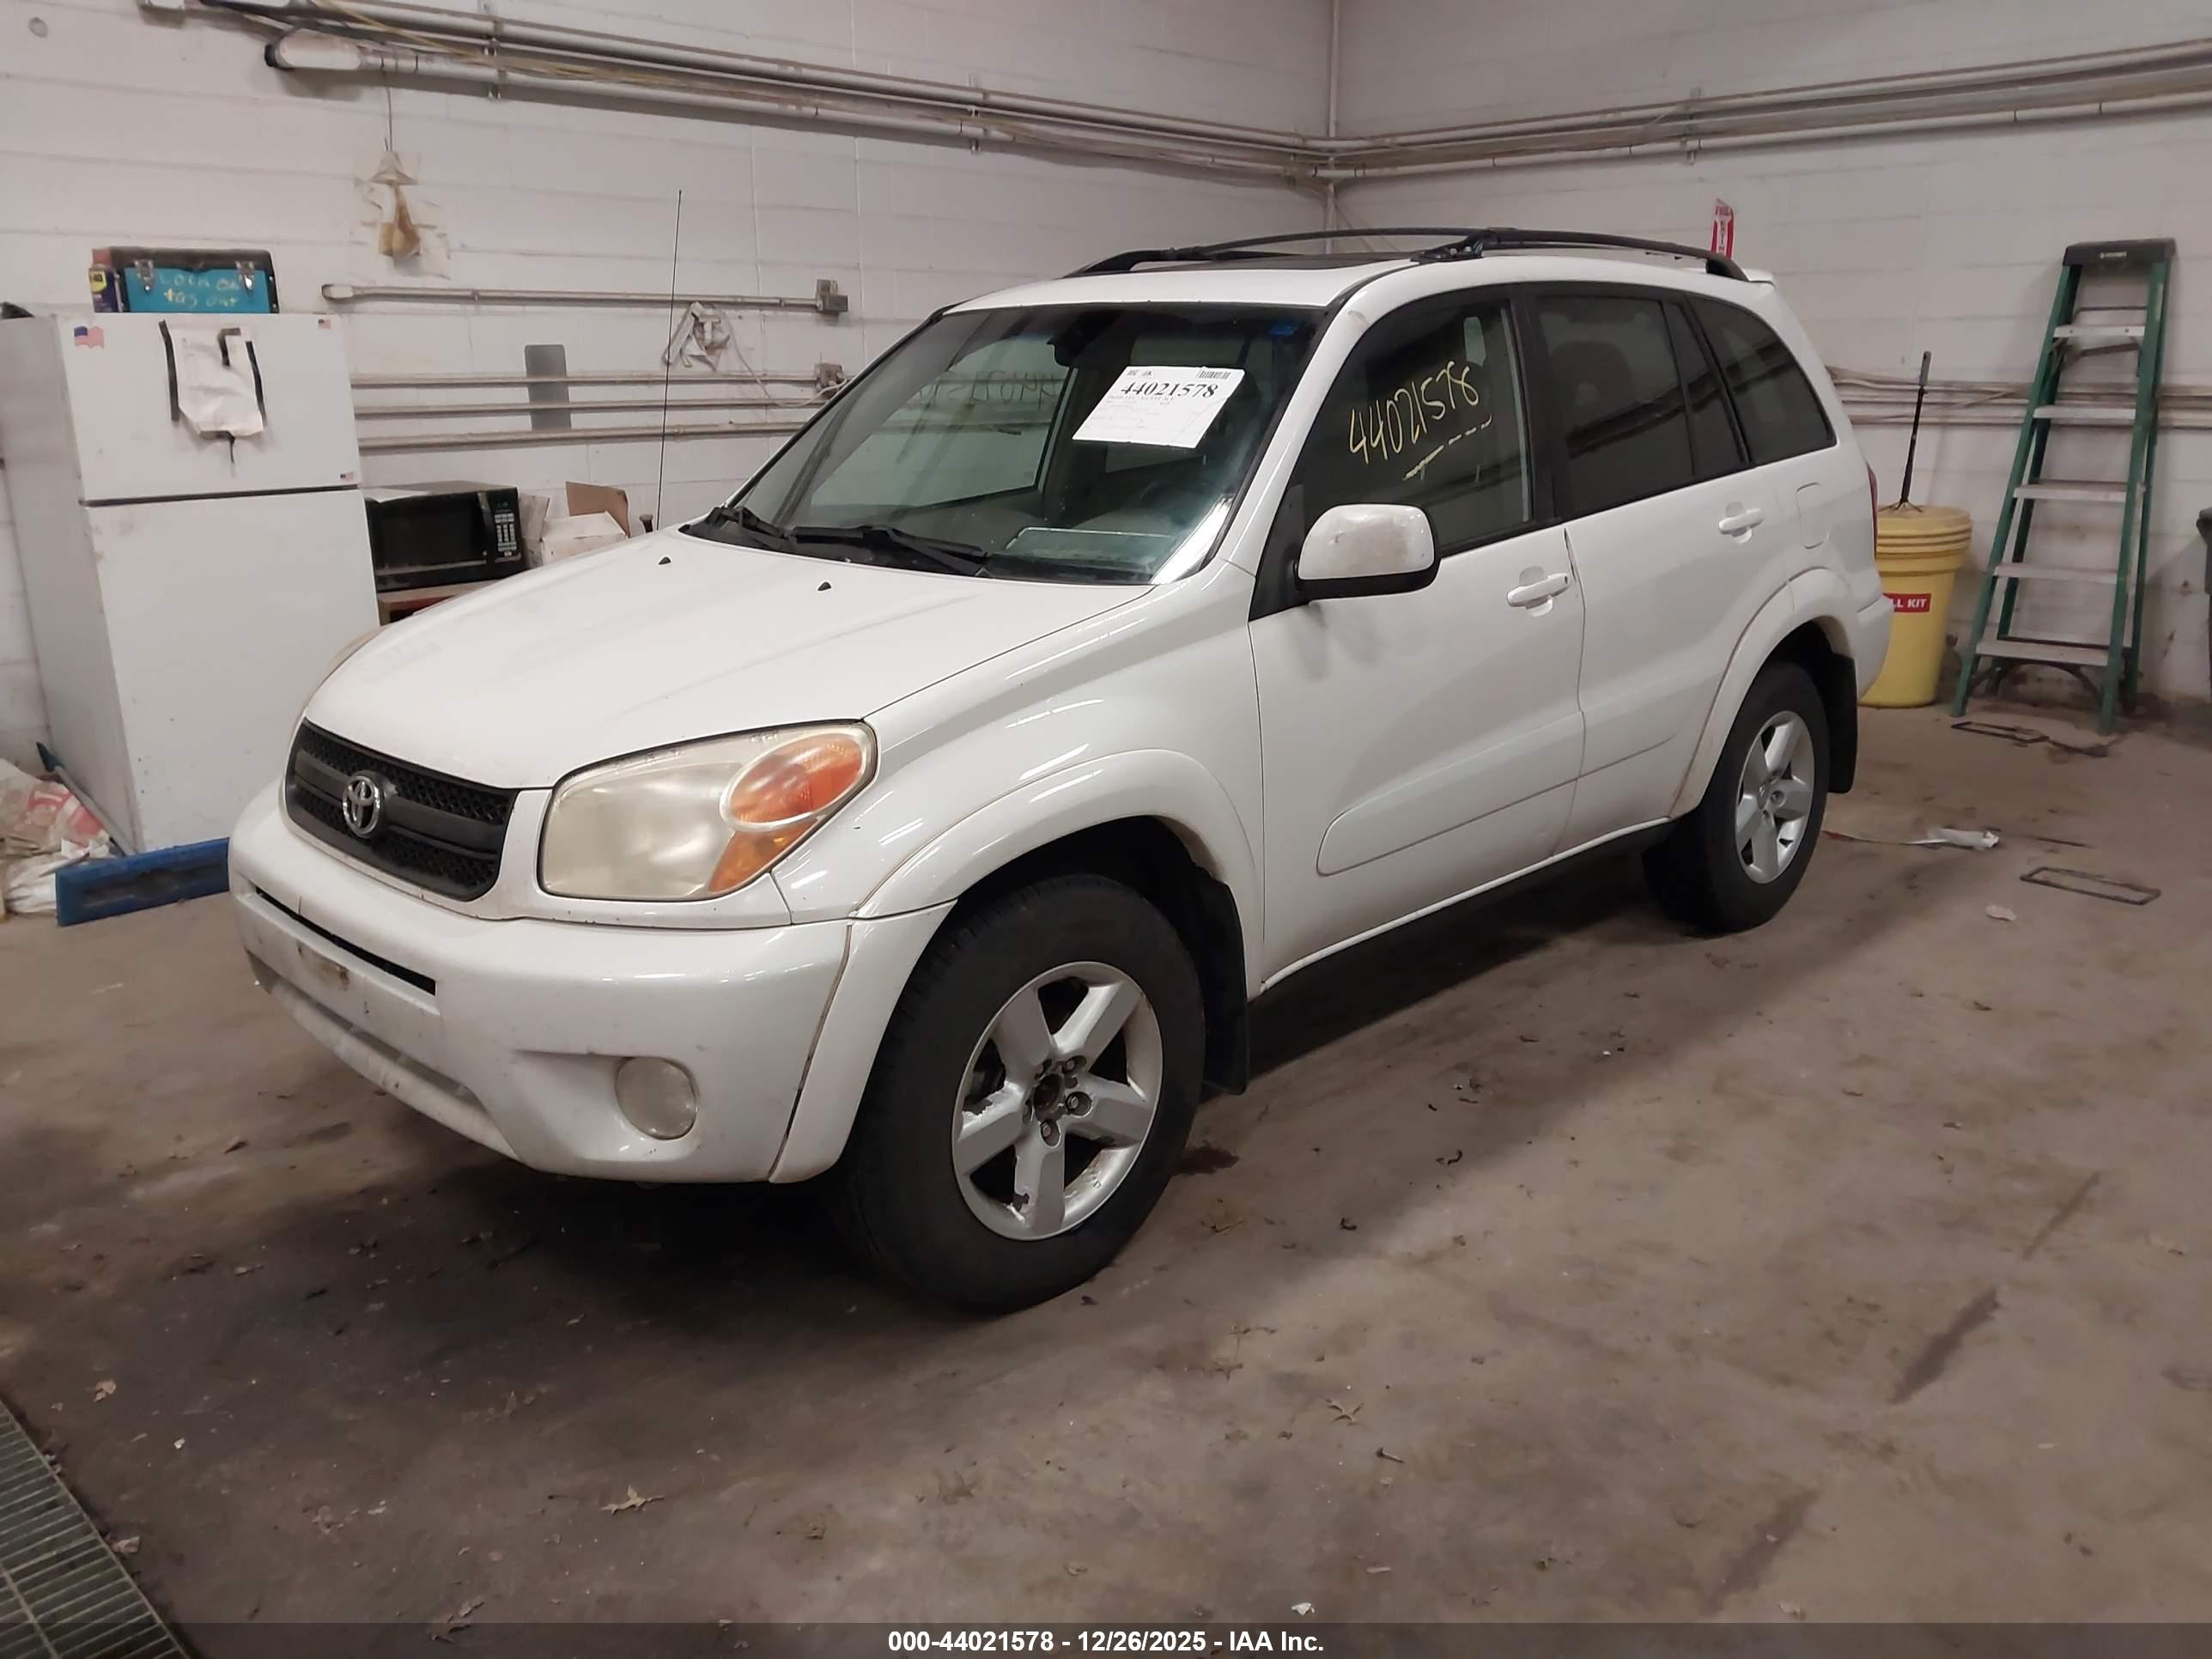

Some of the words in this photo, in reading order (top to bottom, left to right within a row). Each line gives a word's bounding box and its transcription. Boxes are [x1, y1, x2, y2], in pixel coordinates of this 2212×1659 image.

[1121, 381, 1218, 398] 44021578
[1349, 361, 1479, 465] 44021578
[1907, 599, 1927, 608] KIT
